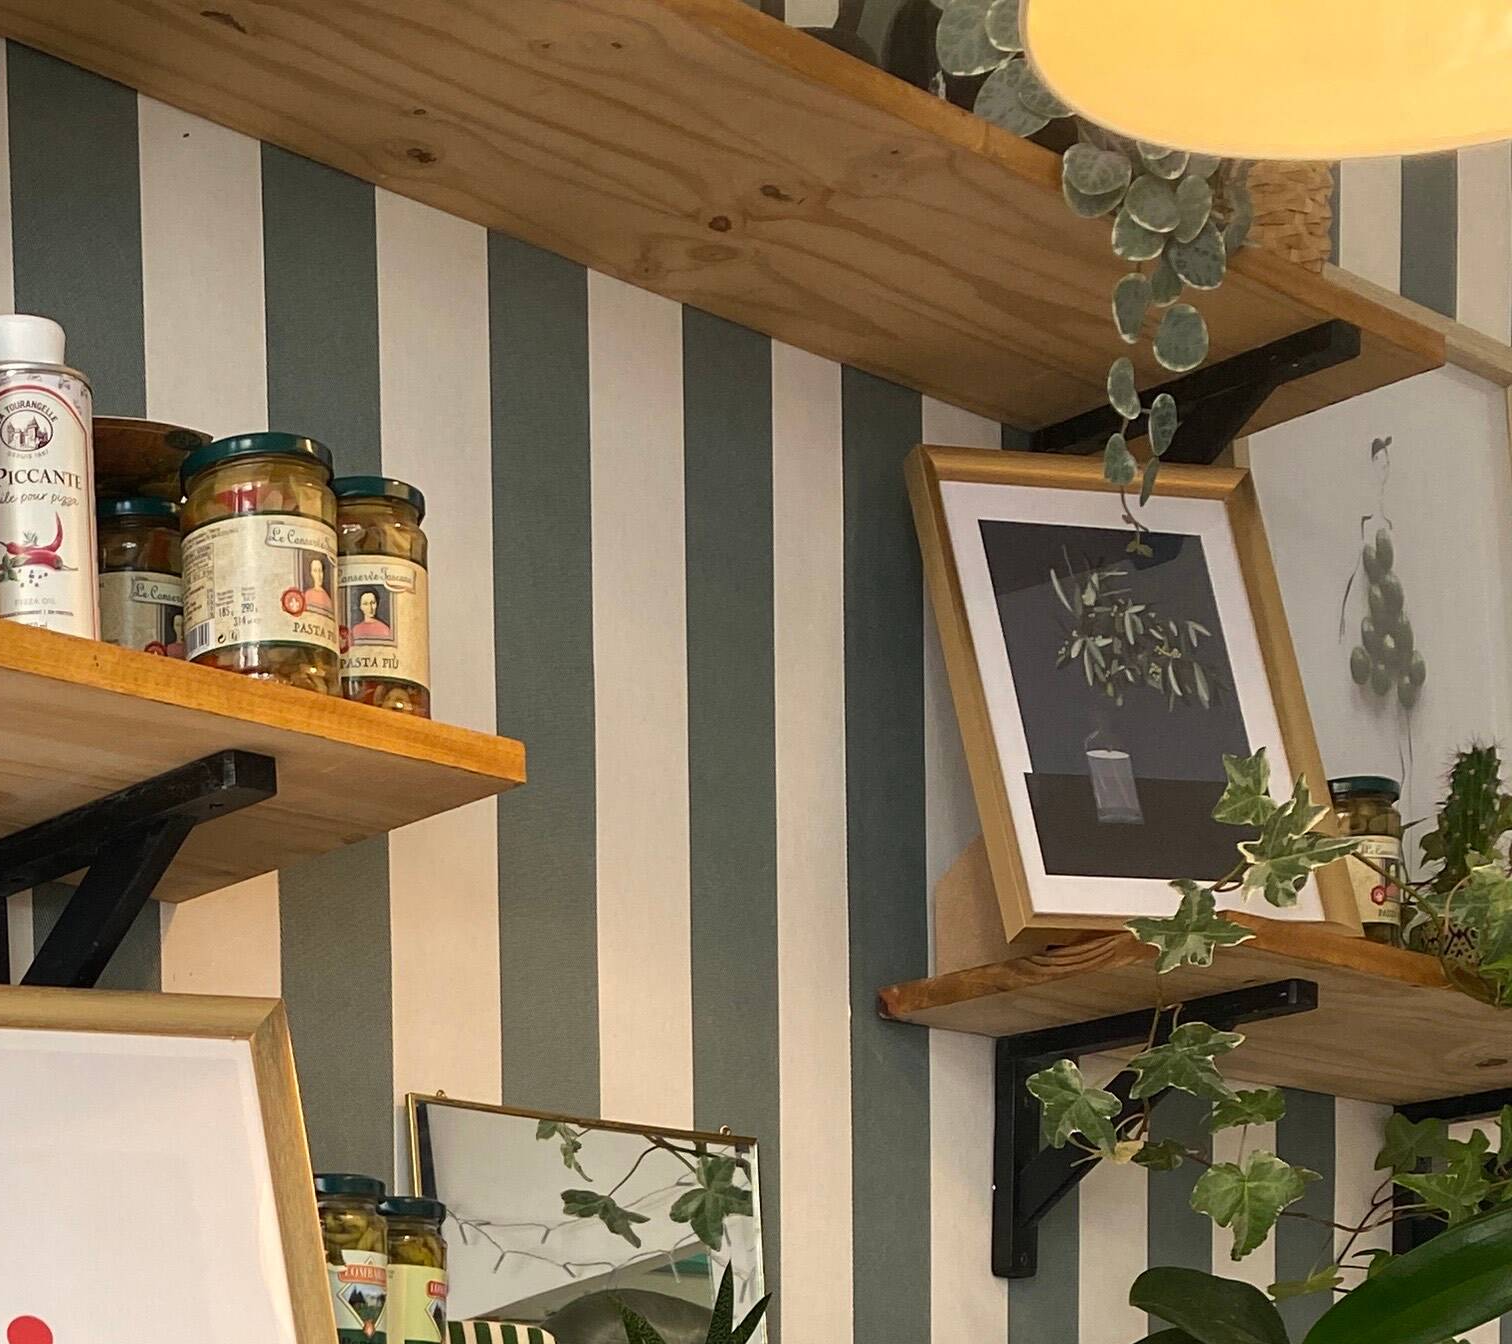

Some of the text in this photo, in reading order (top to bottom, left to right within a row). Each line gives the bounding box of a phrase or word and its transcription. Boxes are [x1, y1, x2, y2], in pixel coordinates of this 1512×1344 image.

[4, 400, 59, 423] TOURANGELLE
[20, 492, 48, 504] pour
[136, 583, 148, 599] Le
[292, 622, 326, 638] PASTA
[340, 656, 379, 670] PASTA
